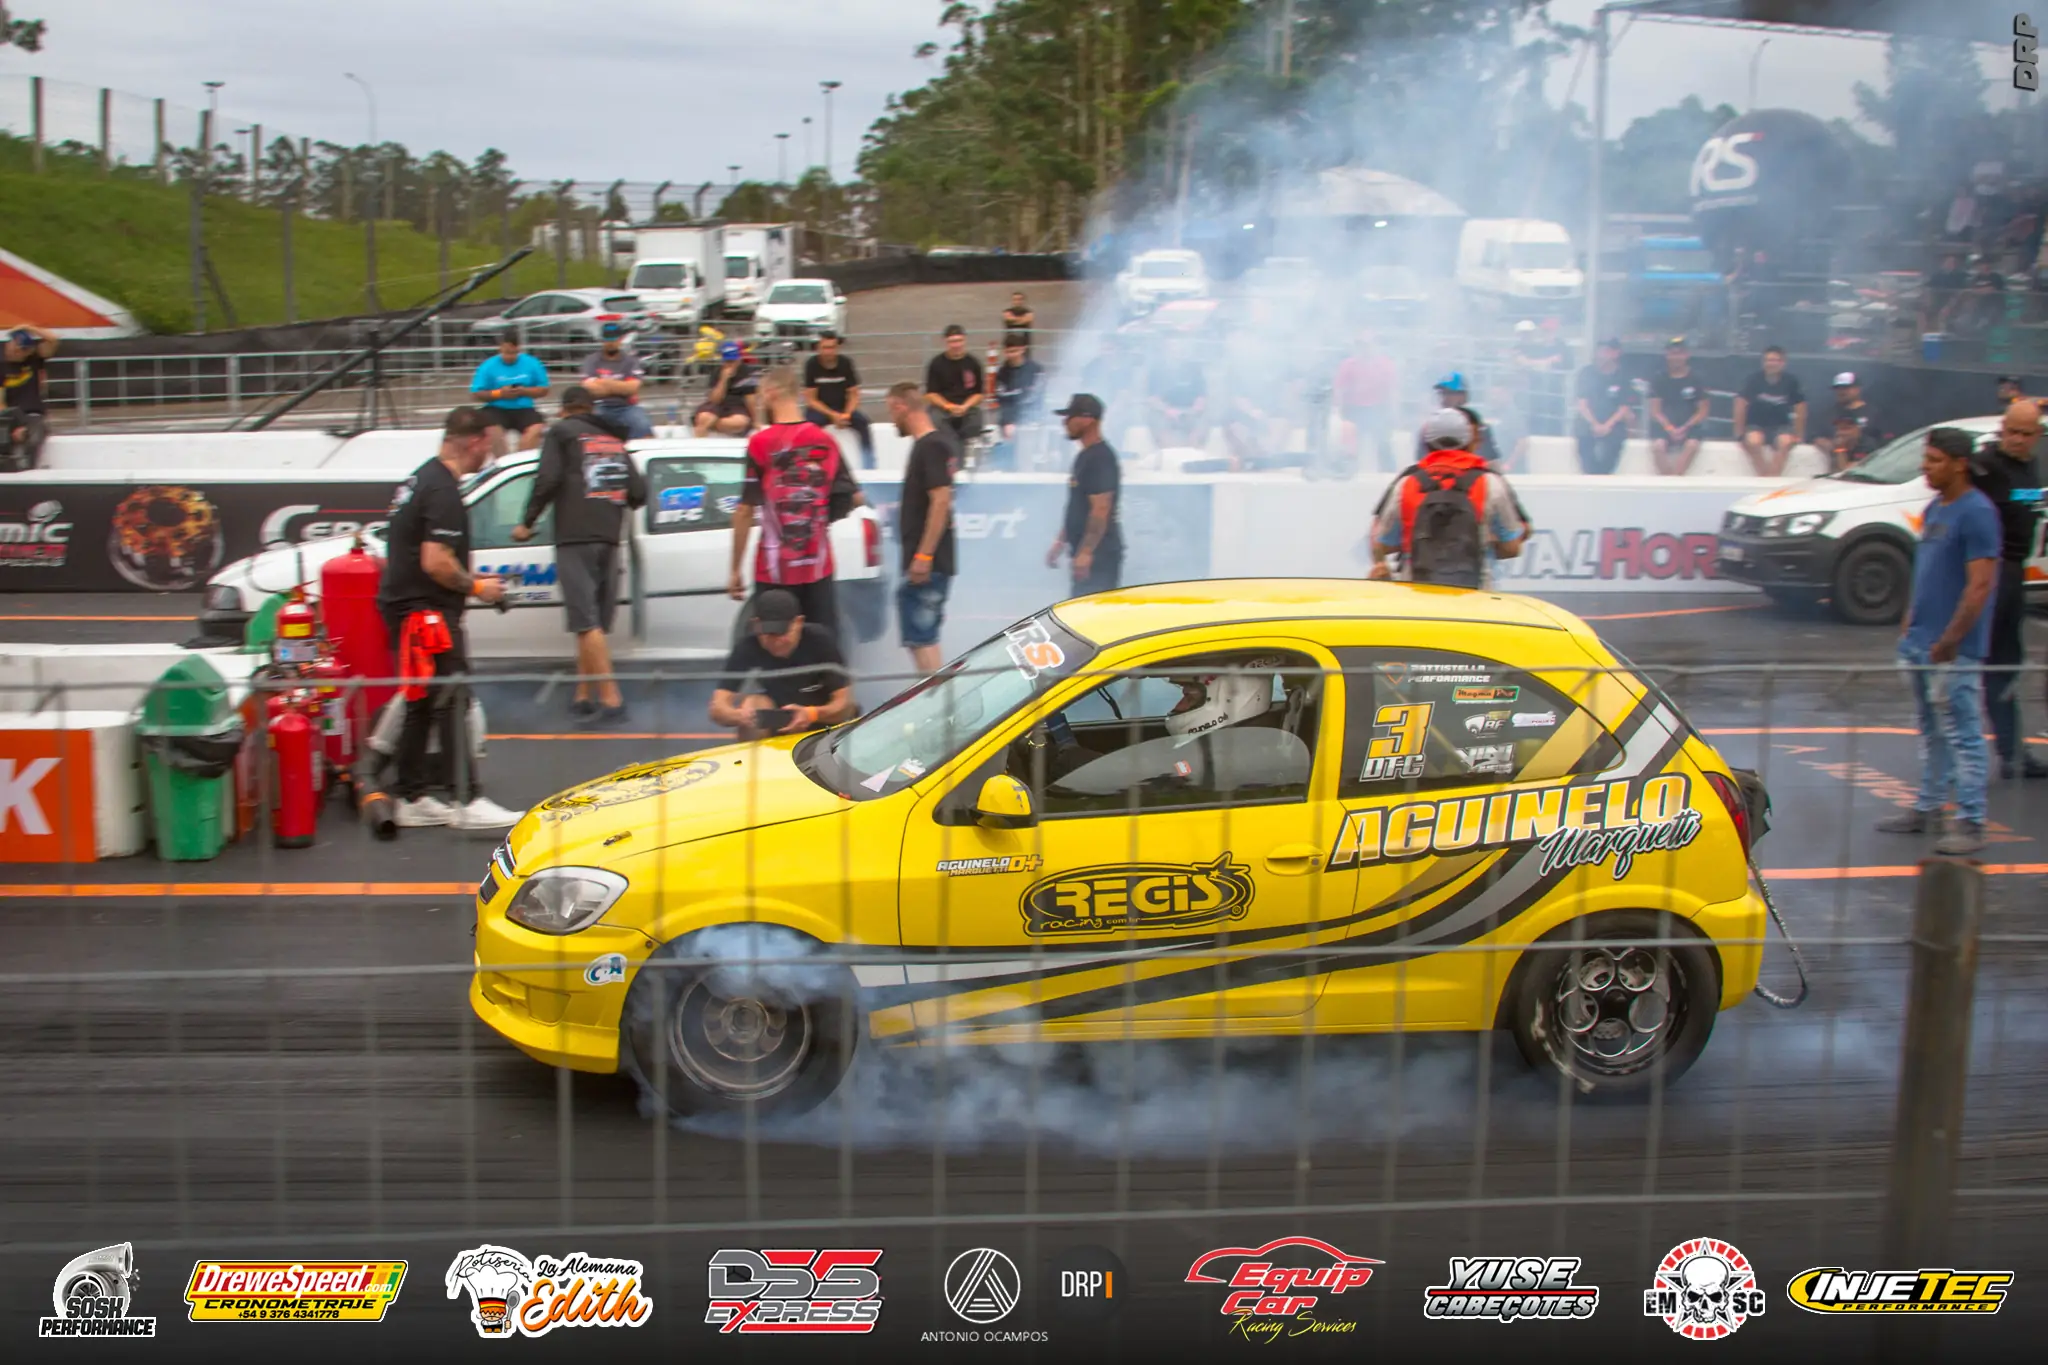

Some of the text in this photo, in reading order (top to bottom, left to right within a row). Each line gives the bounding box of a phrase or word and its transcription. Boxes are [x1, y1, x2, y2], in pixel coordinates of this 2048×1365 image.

[1408, 674, 1491, 683] PERFORMANCE
[1367, 702, 1434, 759] 3
[1327, 774, 1690, 870] AGUINELO
[937, 857, 1010, 871] AGUINELO
[1040, 917, 1102, 930] racing
